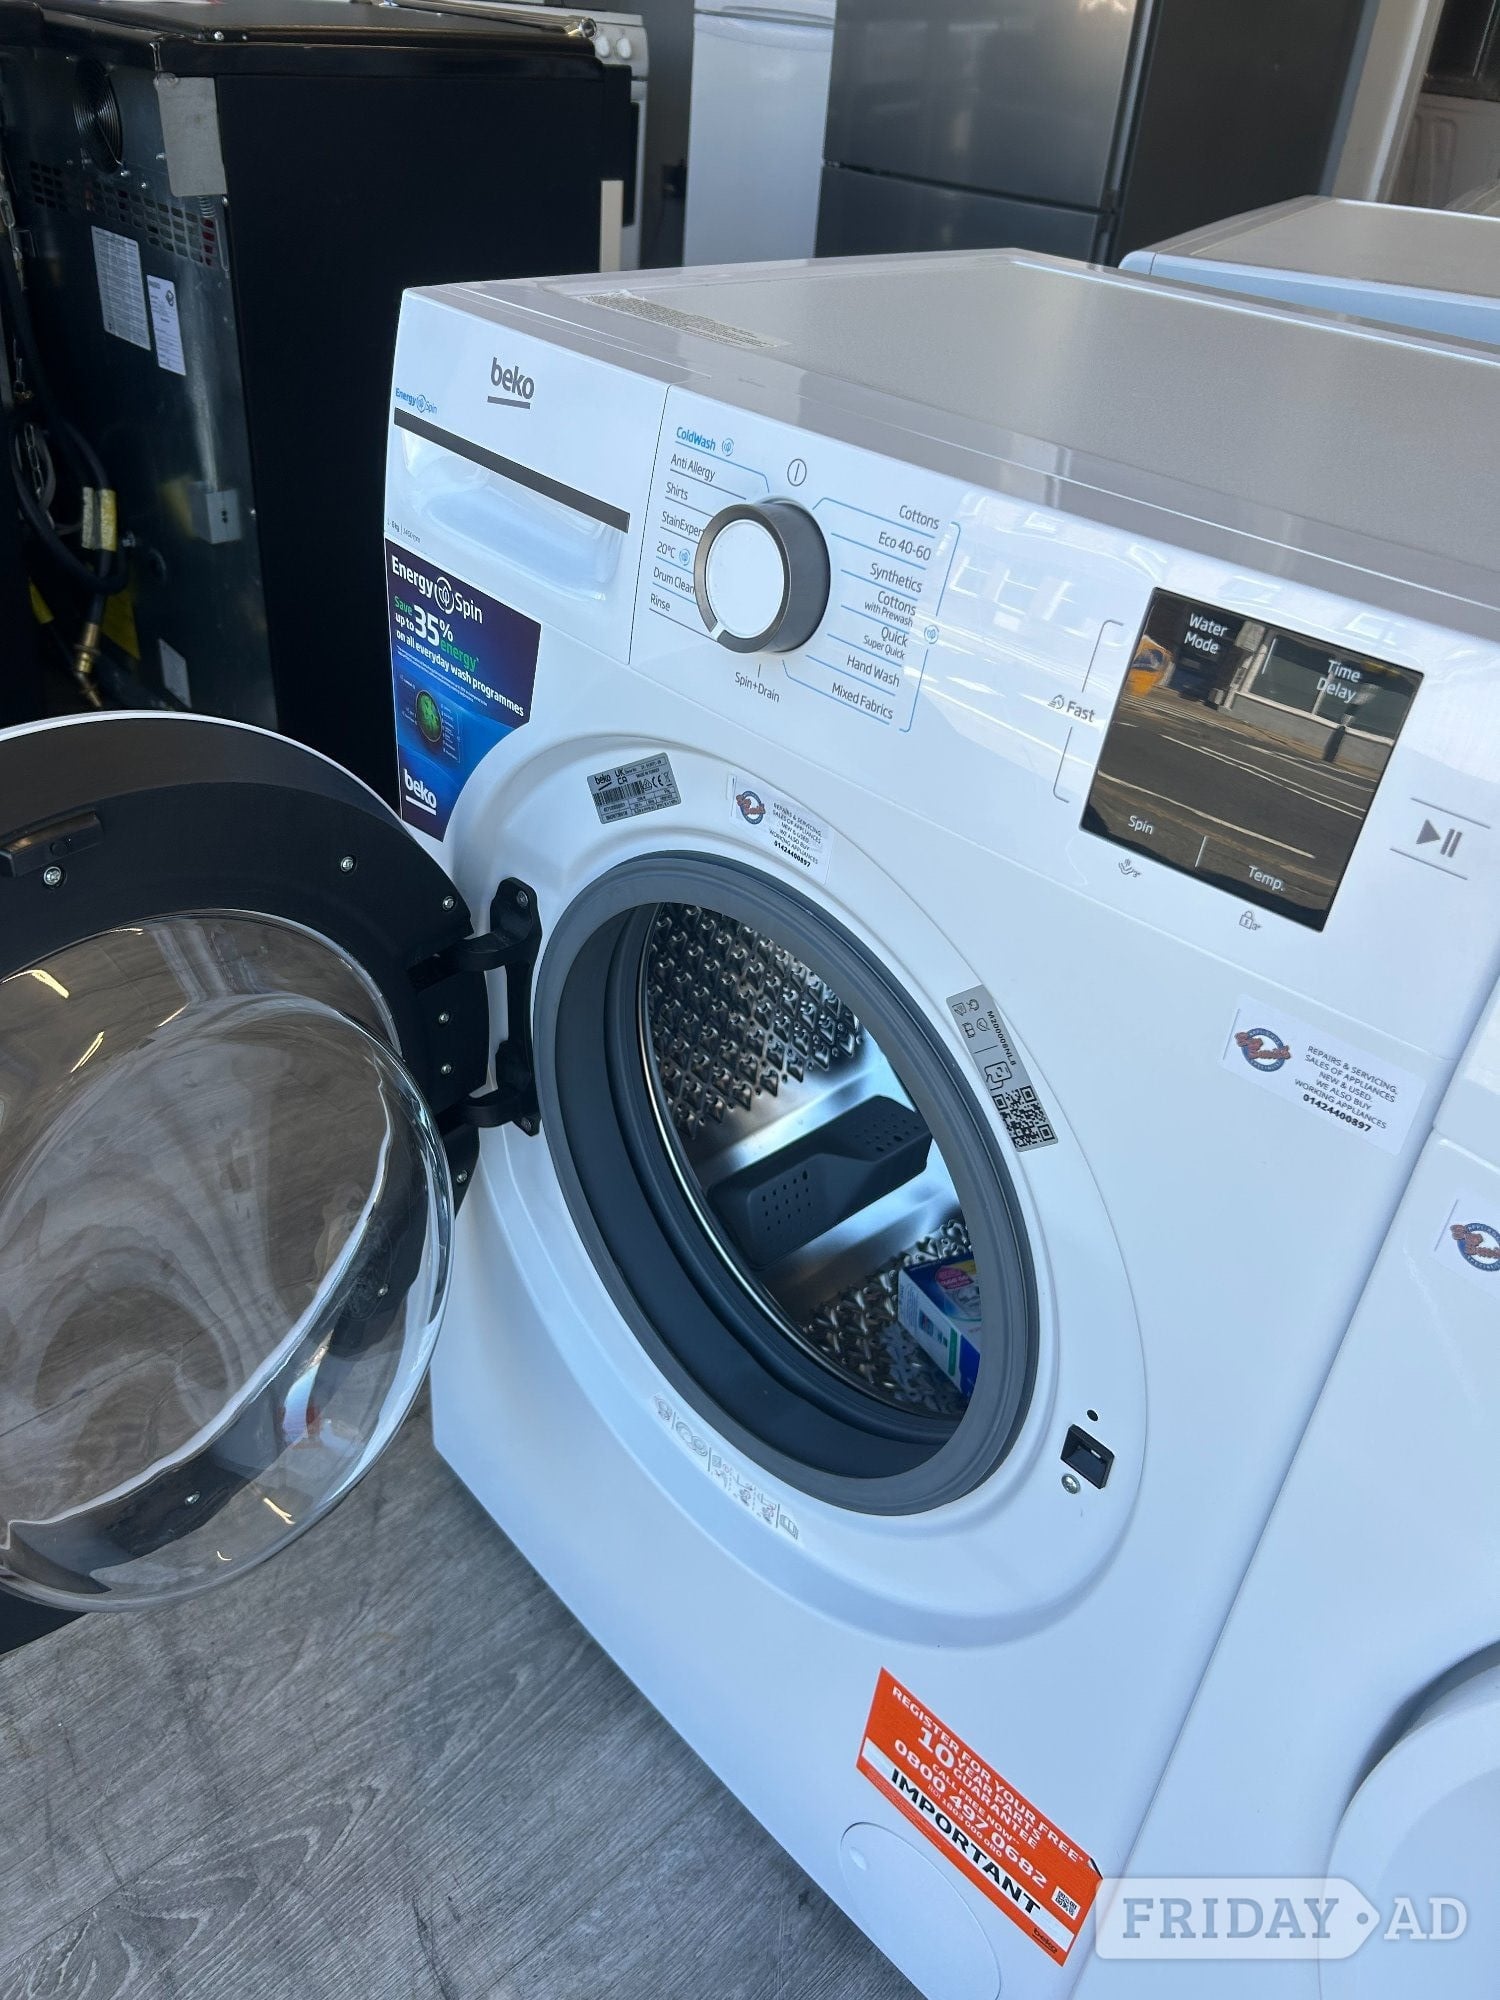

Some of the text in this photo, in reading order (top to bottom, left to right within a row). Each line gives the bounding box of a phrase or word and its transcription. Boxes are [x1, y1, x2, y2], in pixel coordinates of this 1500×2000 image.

[491, 357, 534, 400] beko
[396, 388, 416, 406] Energy
[676, 426, 716, 452] ColdWash
[670, 453, 716, 482] Anti Allergy
[666, 482, 688, 500] Shirts
[899, 505, 940, 530] Cottons
[878, 531, 932, 561] Eco 40-60
[392, 554, 483, 624] Energy Spin
[653, 566, 696, 596] Drum Clean
[870, 563, 922, 594] Synthetics
[394, 596, 413, 616] Save
[650, 594, 671, 612] Rinse
[864, 600, 914, 628] with Prewash
[877, 590, 916, 616] Cottons
[396, 612, 414, 632] up to
[1188, 613, 1228, 638] Water
[863, 634, 905, 660] Super Quick
[881, 626, 909, 648] Quick
[1184, 631, 1220, 655] Mode
[396, 629, 524, 717] on all everyday wash programmes
[846, 654, 900, 688] Hand Wash
[1326, 659, 1362, 683] Time
[735, 671, 780, 704] Spin+Drain
[831, 682, 894, 720] Mixed Fabrics
[1316, 677, 1356, 704] Delay
[1064, 699, 1096, 724] Fast
[404, 768, 438, 809] beko
[1128, 815, 1154, 835] Spin
[1248, 864, 1285, 892] Temp.
[1307, 1046, 1342, 1067] REPAIRS
[1342, 1062, 1350, 1070] &
[1305, 1054, 1396, 1103] SALES OF APPLIANCES
[1319, 1071, 1339, 1085] NEW
[1340, 1081, 1347, 1089] &
[1294, 1078, 1387, 1129] WORKING APPLIANCES
[1316, 1079, 1372, 1110] WE ALSO BUY
[1302, 1094, 1372, 1132] 01424400897
[892, 1686, 960, 1754] REGISTER
[962, 1751, 991, 1783] FOR
[994, 1779, 1036, 1825] YOUR
[918, 1726, 955, 1768] 10
[932, 1763, 957, 1790] CALL
[958, 1788, 986, 1816] FREE
[958, 1758, 1041, 1840] YEAR PARTS
[894, 1739, 946, 1793] 0800
[949, 1794, 989, 1831] 497
[990, 1832, 1048, 1889] 0682
[953, 1768, 1038, 1850] GUARANTEE
[891, 1768, 1041, 1914] IMPORTANT
